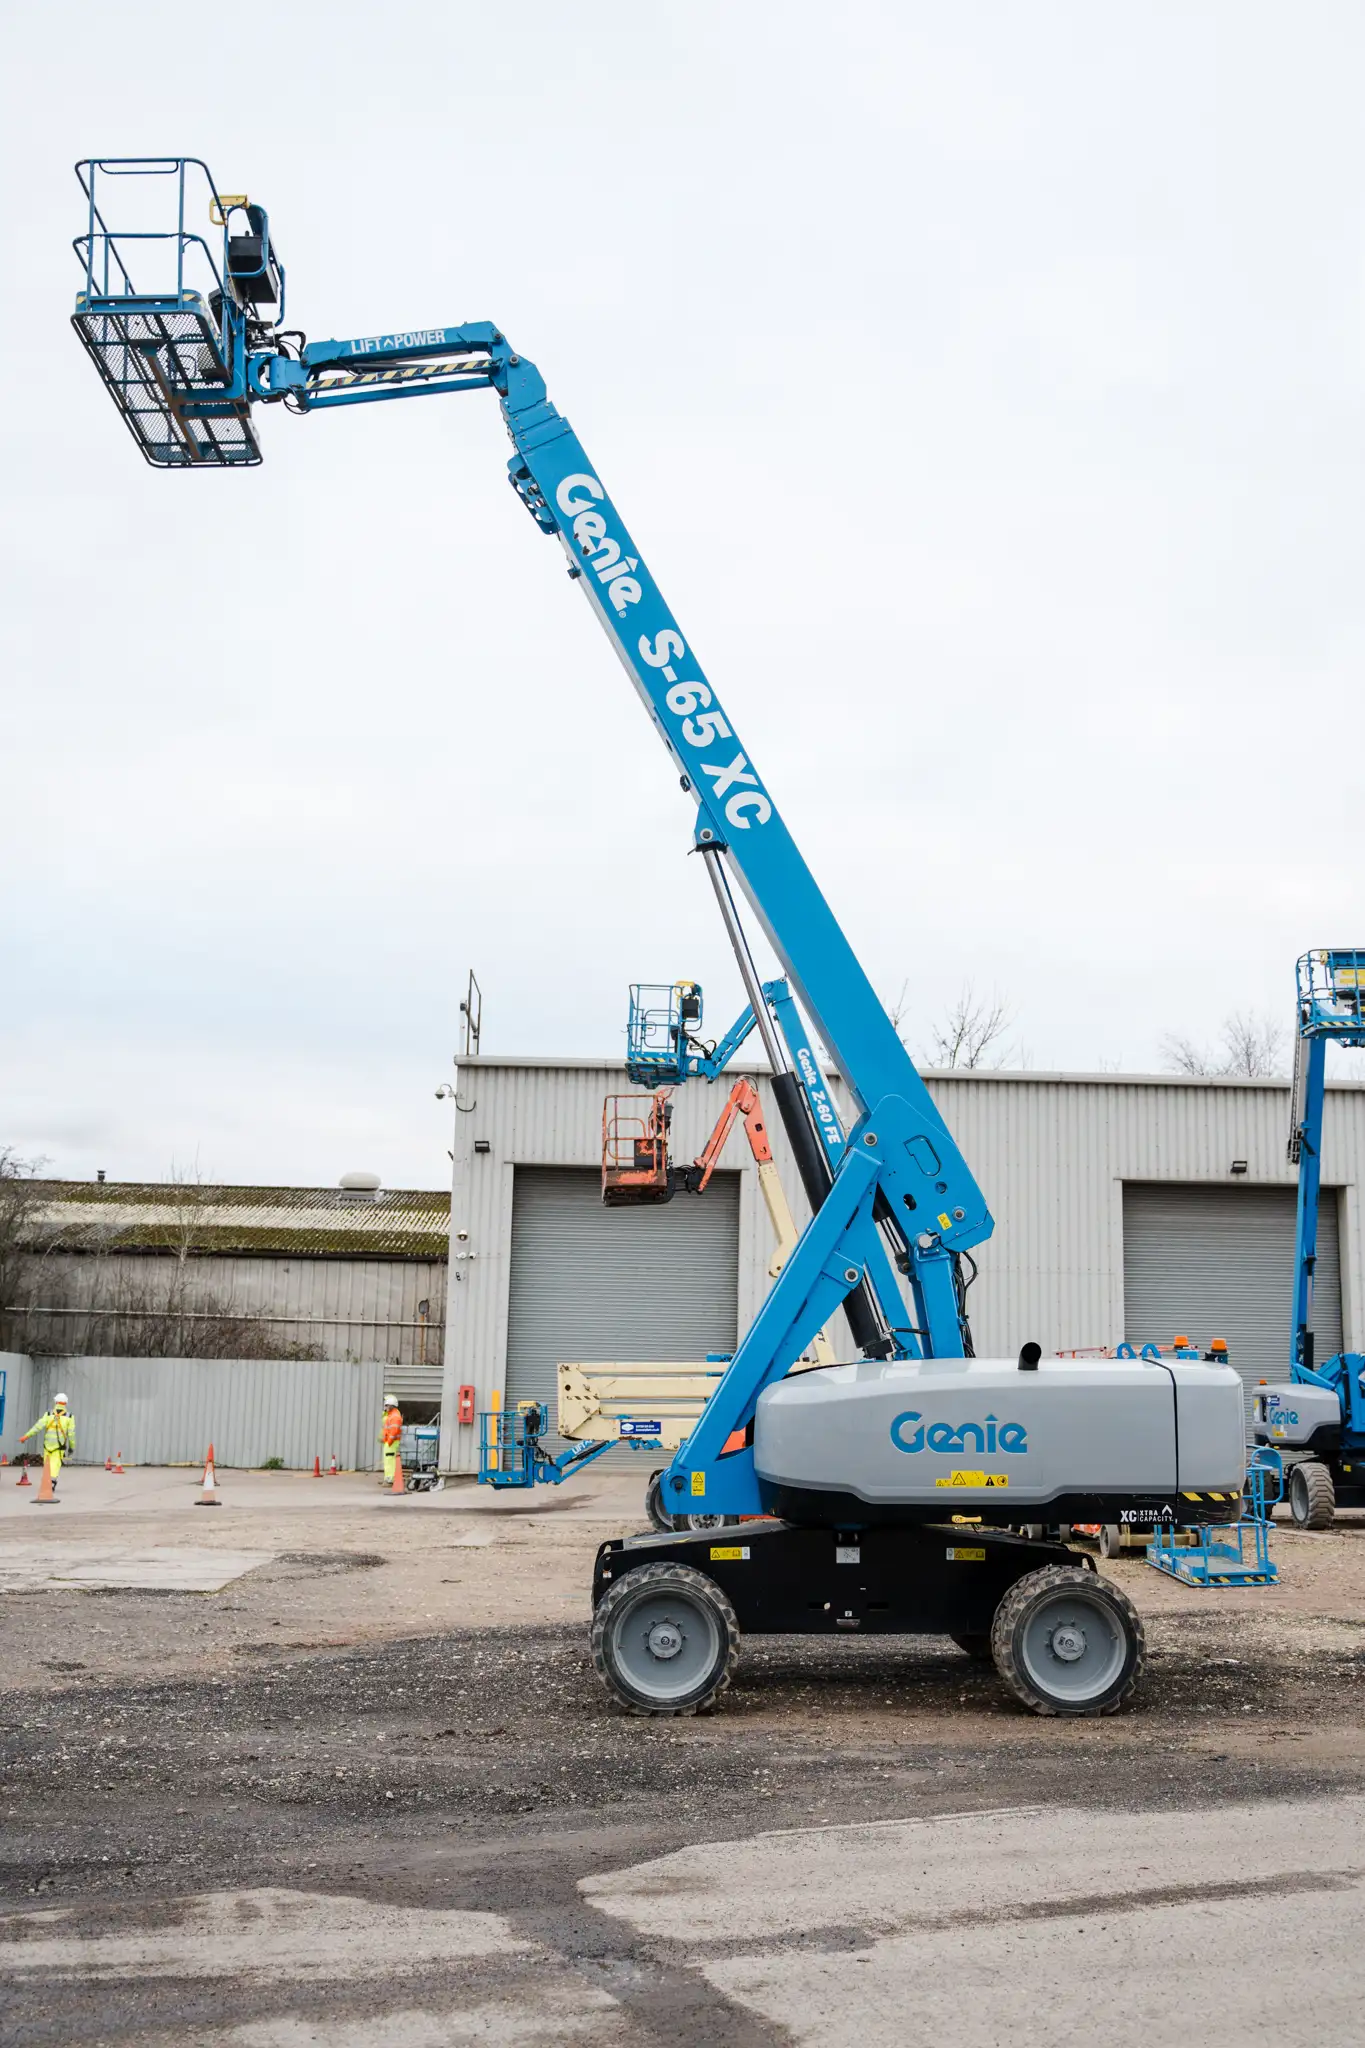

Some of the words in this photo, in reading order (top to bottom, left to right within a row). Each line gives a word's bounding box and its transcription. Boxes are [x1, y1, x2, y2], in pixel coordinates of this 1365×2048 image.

[351, 337, 381, 354] LIFT
[394, 330, 446, 348] POWER
[556, 473, 643, 613] Genie
[638, 629, 733, 747] S-65
[700, 752, 772, 829] XC
[797, 1047, 817, 1087] Genie
[812, 1090, 834, 1123] Z-60
[824, 1126, 841, 1144] FE
[889, 1411, 1028, 1454] Genie
[1120, 1510, 1137, 1523] XC
